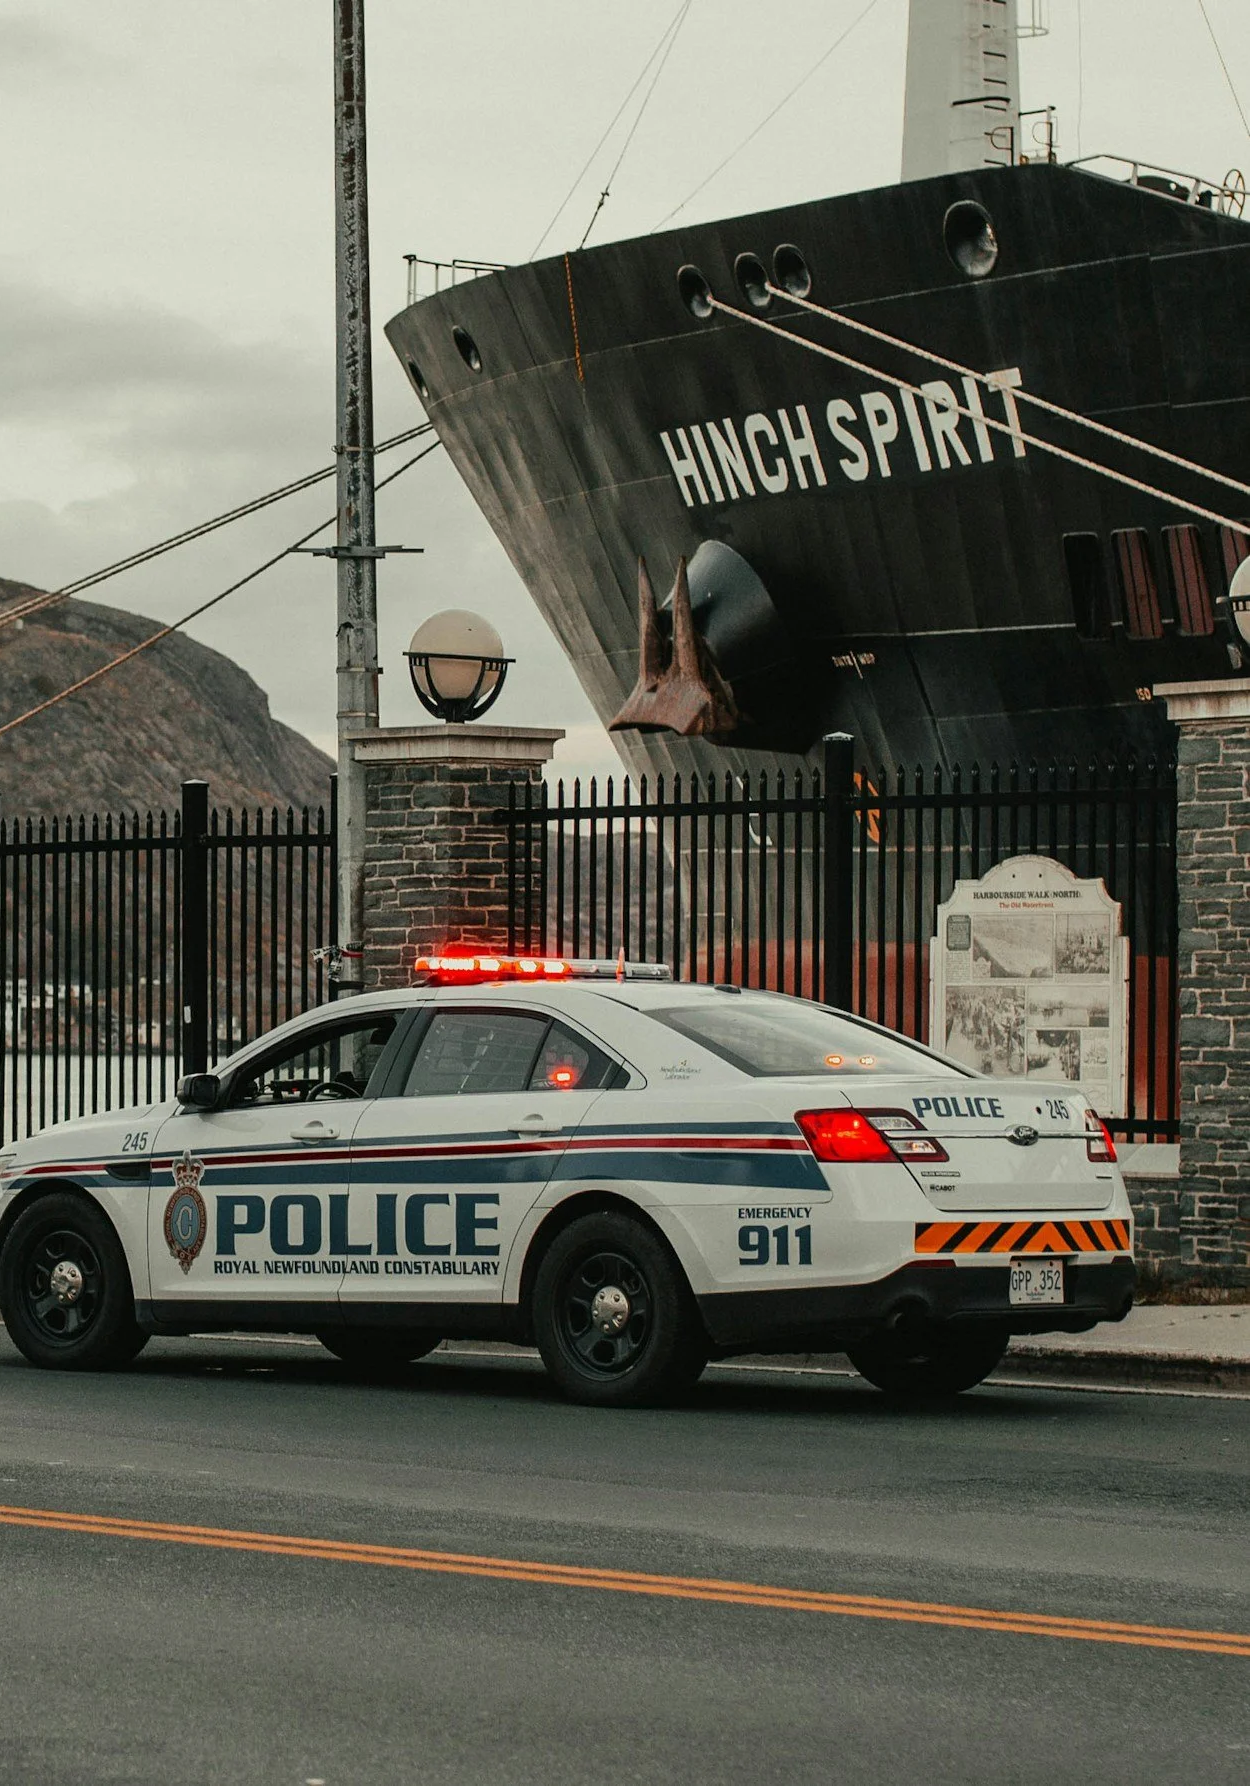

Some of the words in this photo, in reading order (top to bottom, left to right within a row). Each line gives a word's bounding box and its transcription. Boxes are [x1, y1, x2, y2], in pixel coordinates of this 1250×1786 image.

[660, 404, 827, 507] HINCH
[826, 367, 1027, 482] SPIRIT
[973, 891, 1027, 899] HARBOURSIDE
[1027, 890, 1050, 899] WALK
[912, 1097, 1005, 1119] POLICE
[1045, 1099, 1070, 1120] 245
[121, 1131, 149, 1152] 245
[935, 1184, 956, 1192] CABOT
[175, 1204, 193, 1241] C
[737, 1207, 813, 1219] EMERGENCY
[215, 1192, 501, 1256] POLICE
[737, 1224, 813, 1266] 911
[213, 1260, 260, 1275] ROYAL
[263, 1260, 380, 1275] NEWFOUNDLAND
[384, 1260, 501, 1276] CONSTABULARY
[1011, 1270, 1032, 1291] GPP
[1039, 1270, 1061, 1291] 352
